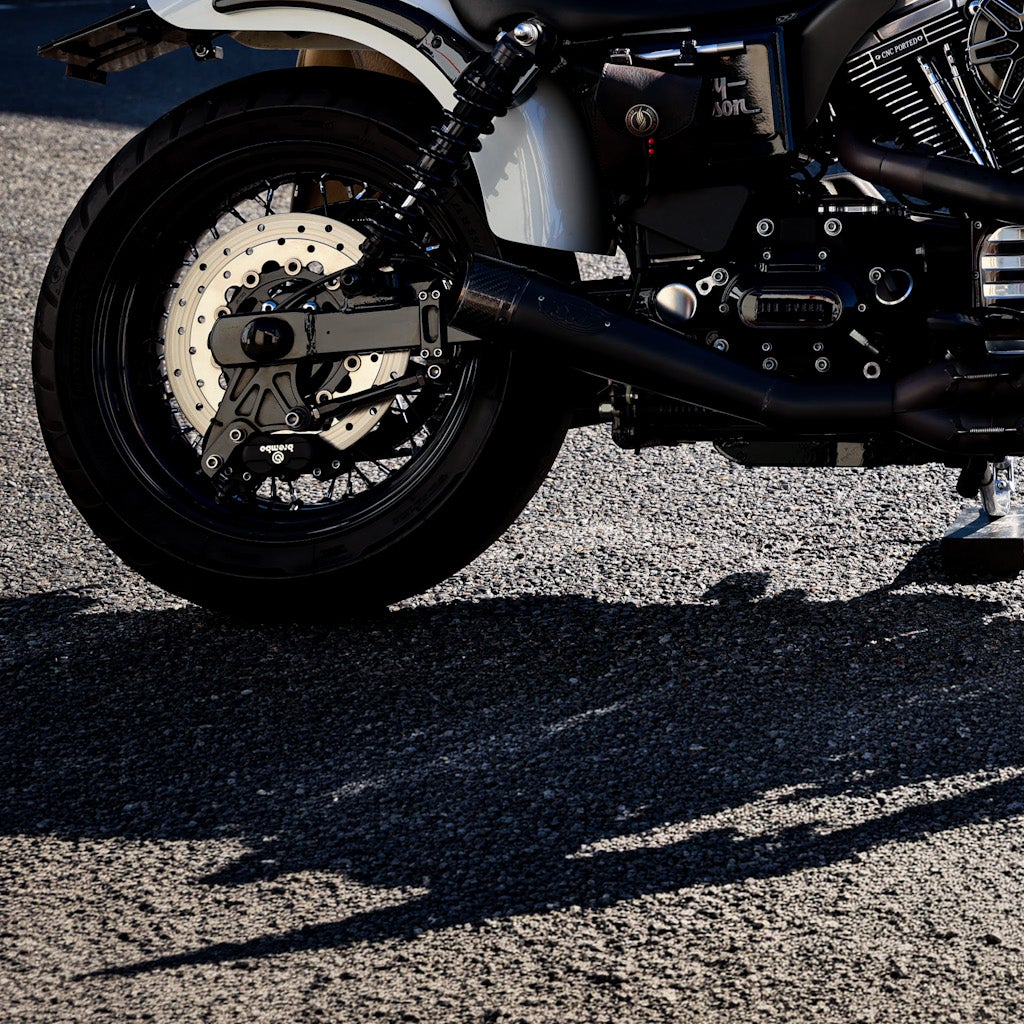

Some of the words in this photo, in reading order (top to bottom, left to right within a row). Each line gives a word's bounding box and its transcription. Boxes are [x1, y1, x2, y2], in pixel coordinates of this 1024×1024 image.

[881, 47, 895, 59] CNC
[894, 37, 918, 53] PORTED
[259, 443, 294, 454] brembo
